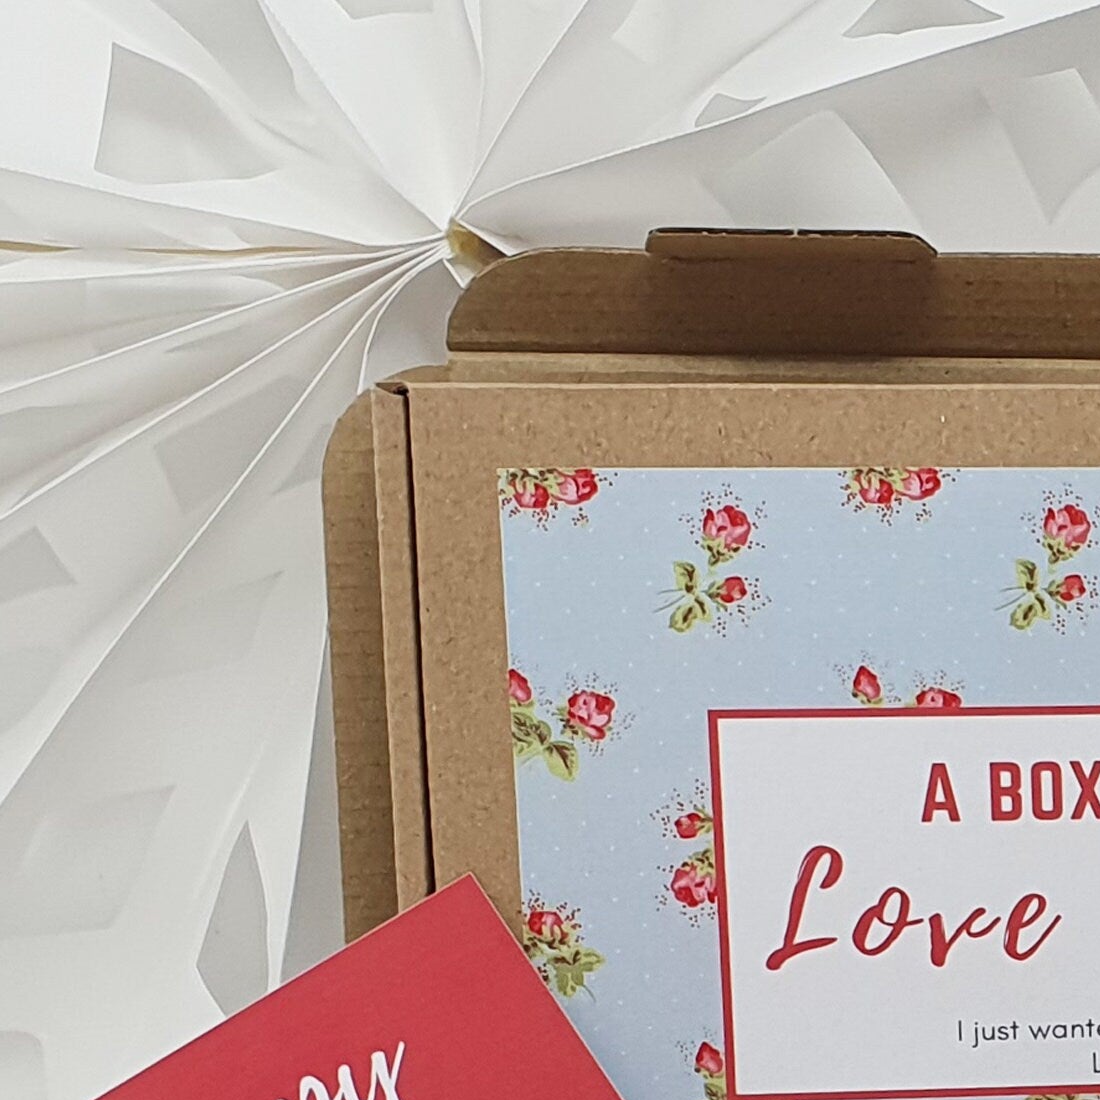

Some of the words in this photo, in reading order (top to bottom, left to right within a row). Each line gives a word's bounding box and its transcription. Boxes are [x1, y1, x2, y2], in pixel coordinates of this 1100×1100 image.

[921, 763, 961, 823] A
[765, 845, 1062, 971] Love
[972, 1019, 1019, 1048] just
